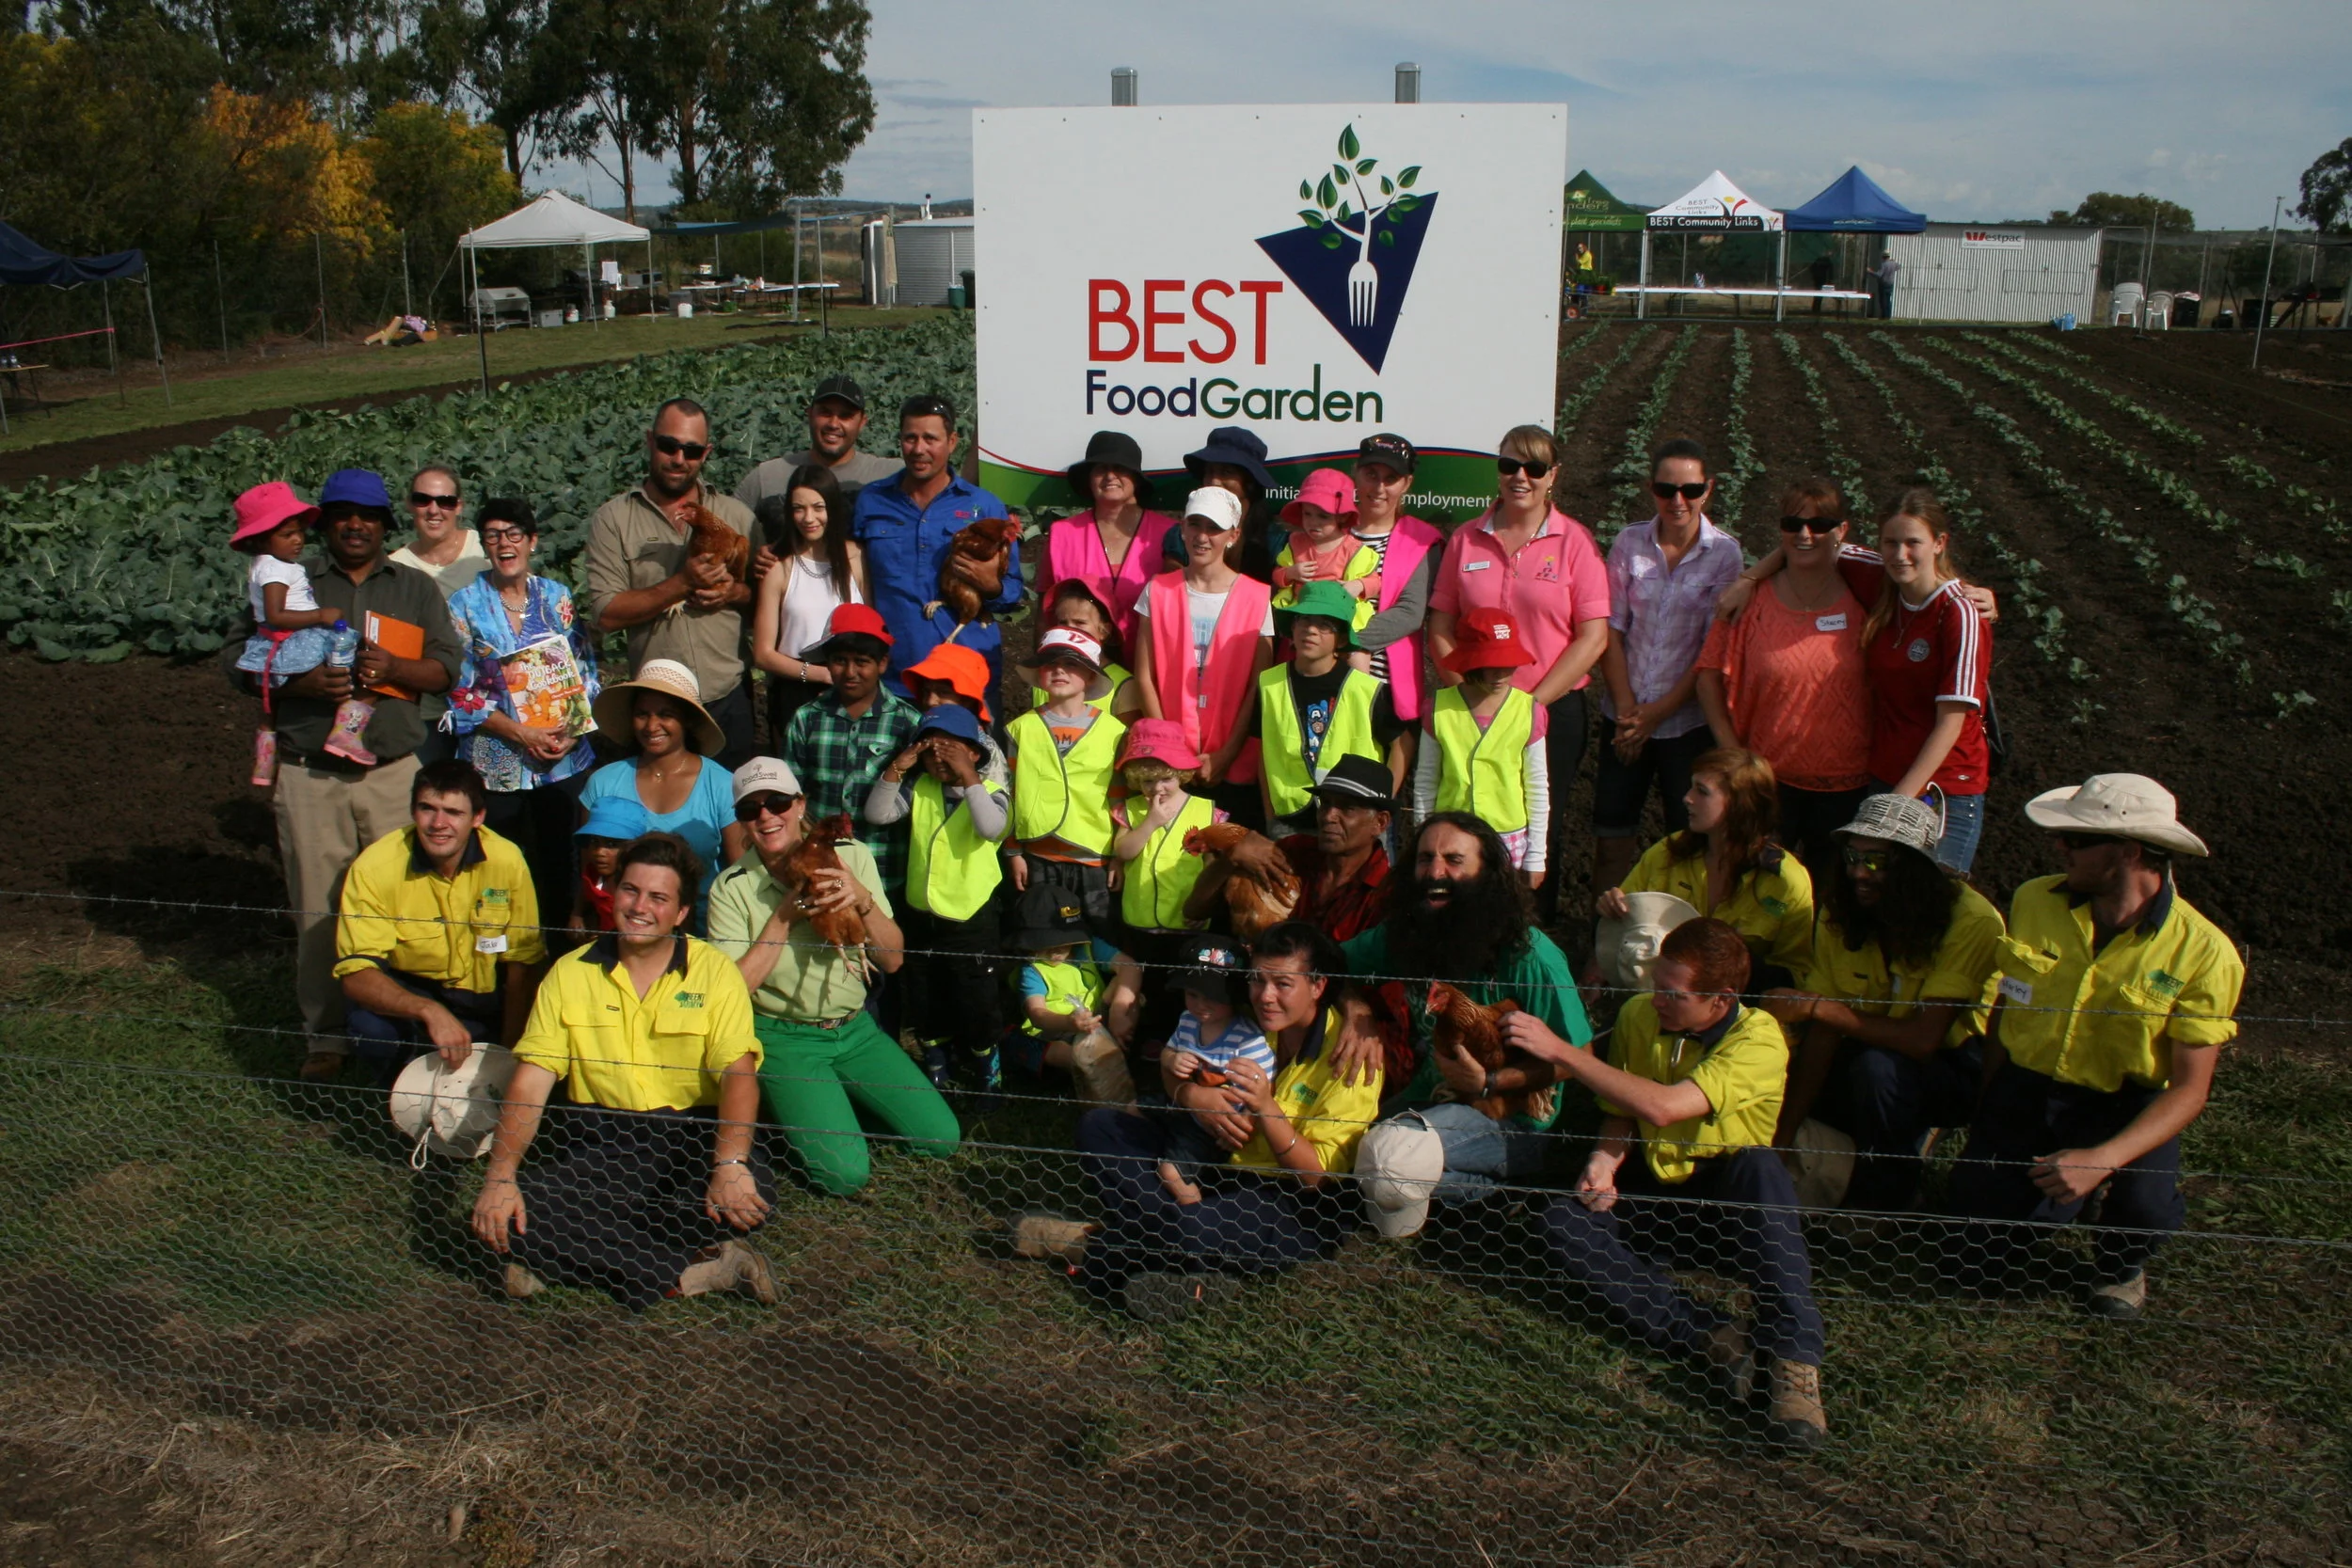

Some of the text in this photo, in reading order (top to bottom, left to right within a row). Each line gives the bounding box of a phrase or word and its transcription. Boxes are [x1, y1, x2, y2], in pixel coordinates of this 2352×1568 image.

[1649, 216, 1758, 229] BEST Community Links
[1965, 231, 2022, 244] Westpac
[1089, 278, 1283, 365] BEST
[1086, 363, 1383, 423] FoodGarden
[1265, 485, 1301, 499] initia
